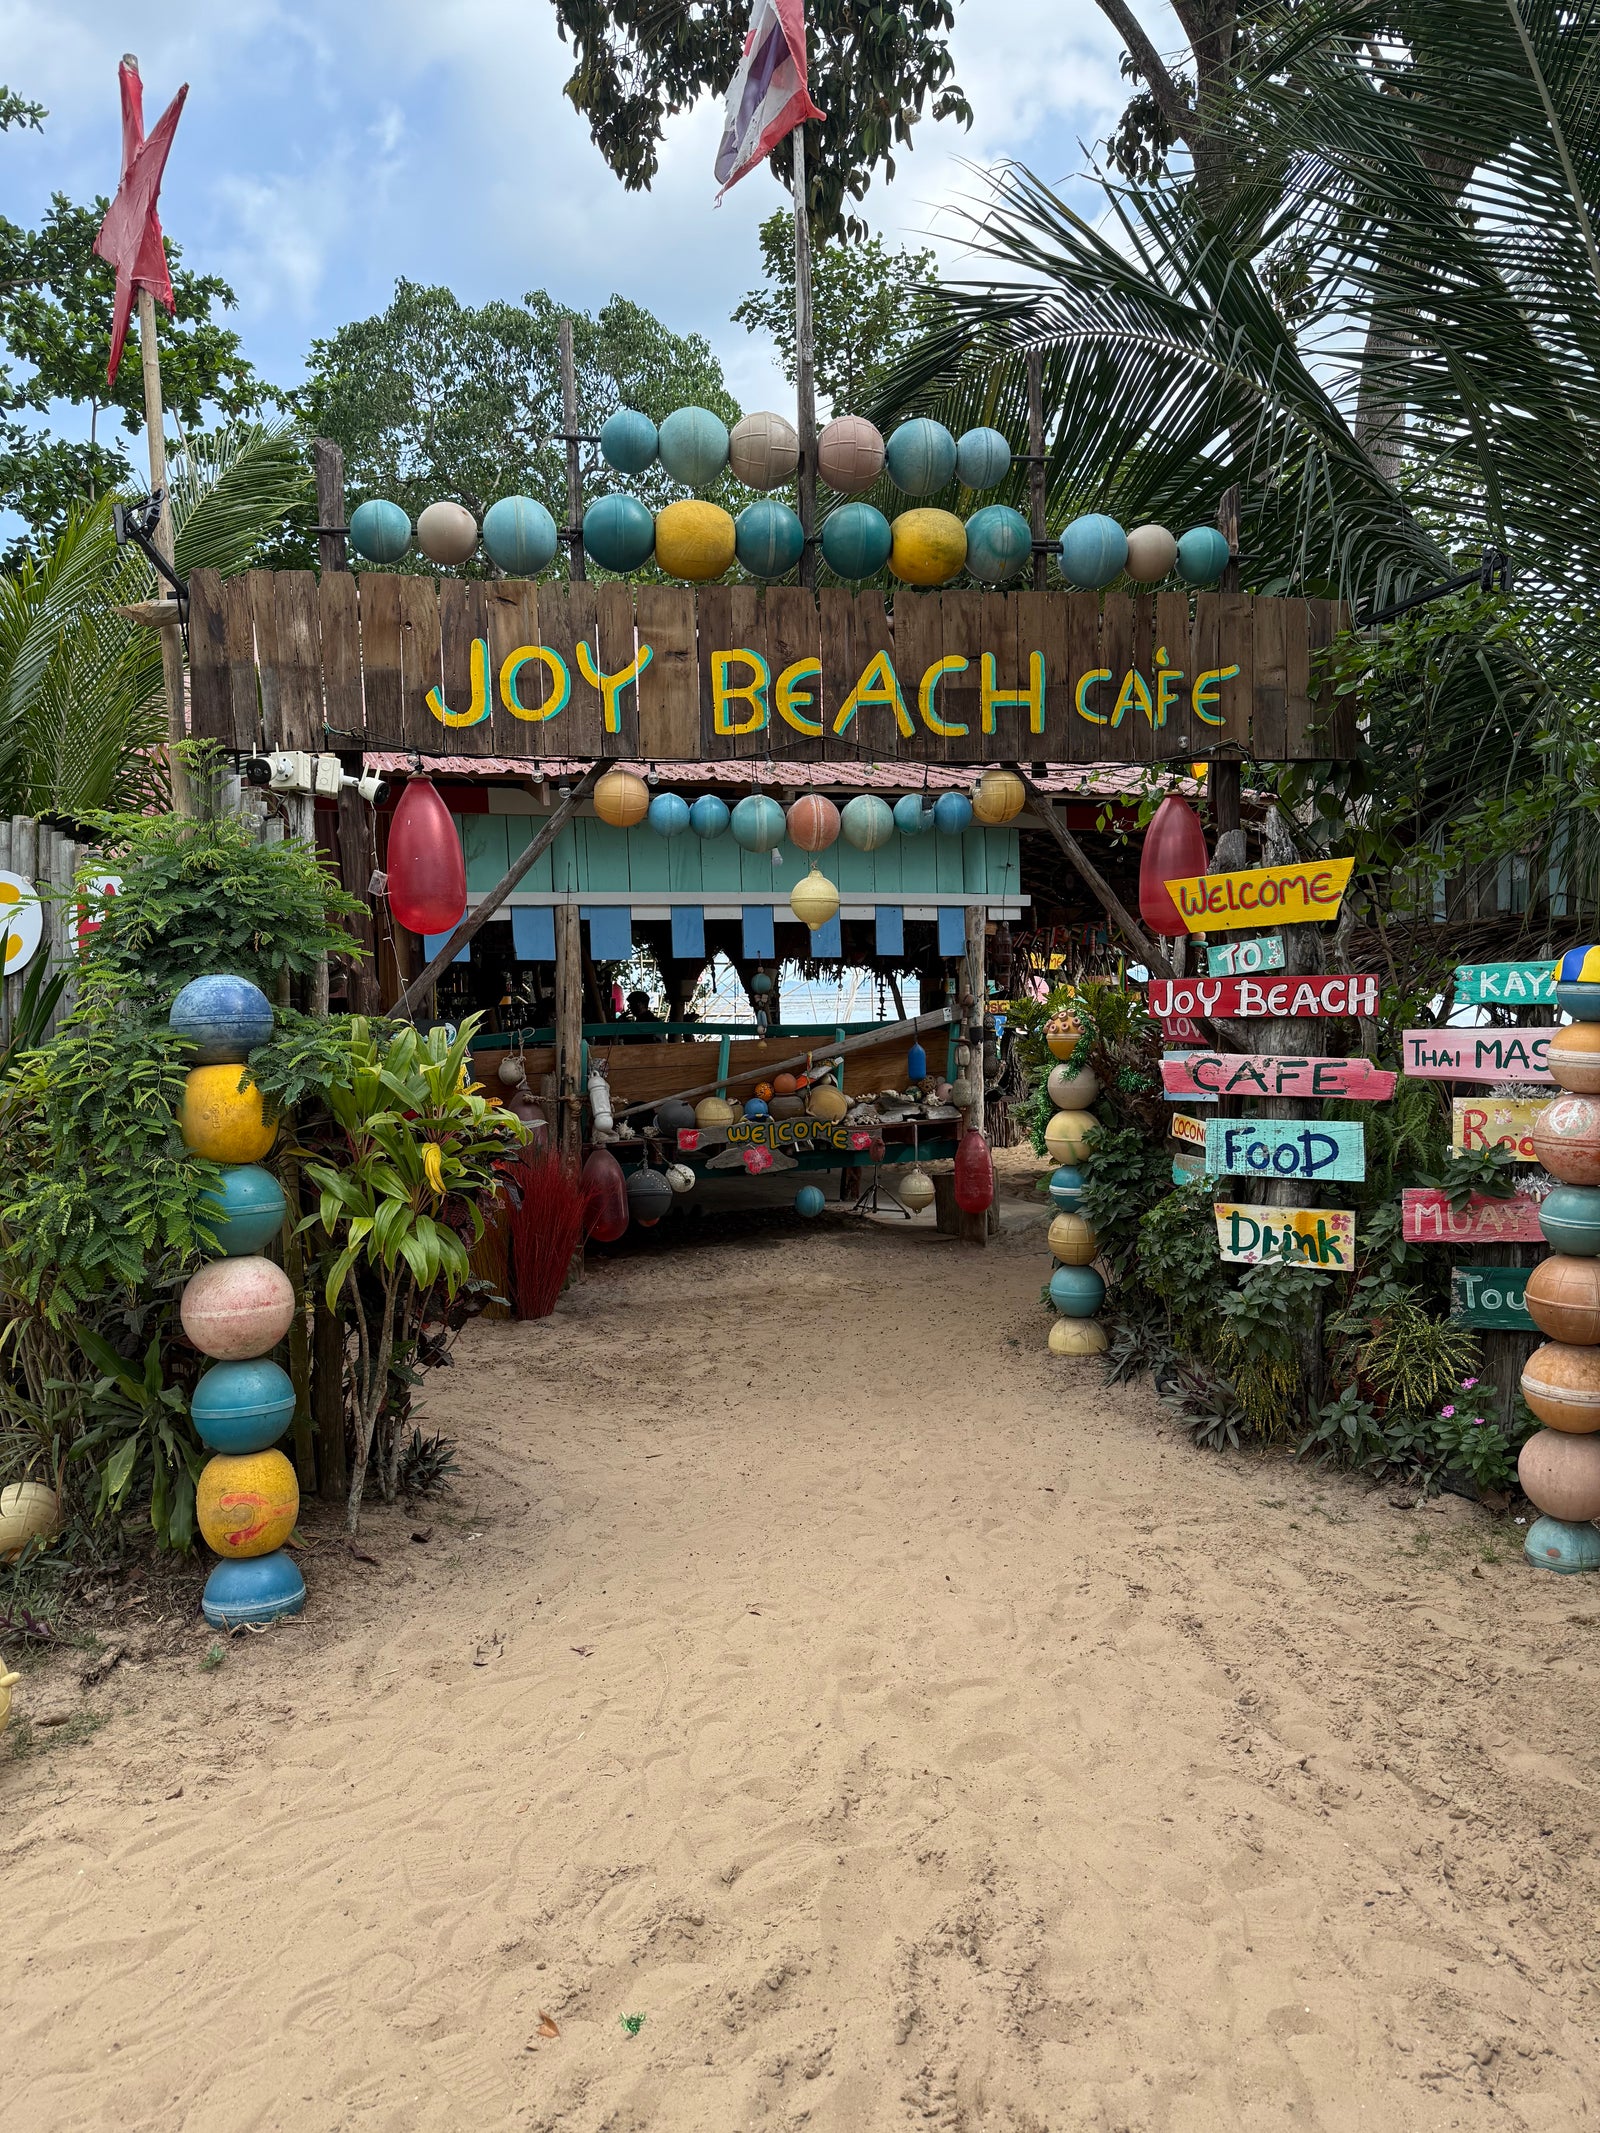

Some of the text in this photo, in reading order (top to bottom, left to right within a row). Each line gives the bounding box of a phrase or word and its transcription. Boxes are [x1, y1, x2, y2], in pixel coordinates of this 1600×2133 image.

[425, 638, 653, 734] JOY
[711, 647, 1046, 739] BEACH
[1180, 872, 1343, 916] WELCOME
[1217, 941, 1264, 976] TO
[1233, 977, 1379, 1017] BEACH
[727, 1121, 848, 1149] WELCOME
[1173, 1116, 1206, 1144] COCON
[1226, 1210, 1344, 1264] Drink
[1415, 1203, 1528, 1235] MUAY
